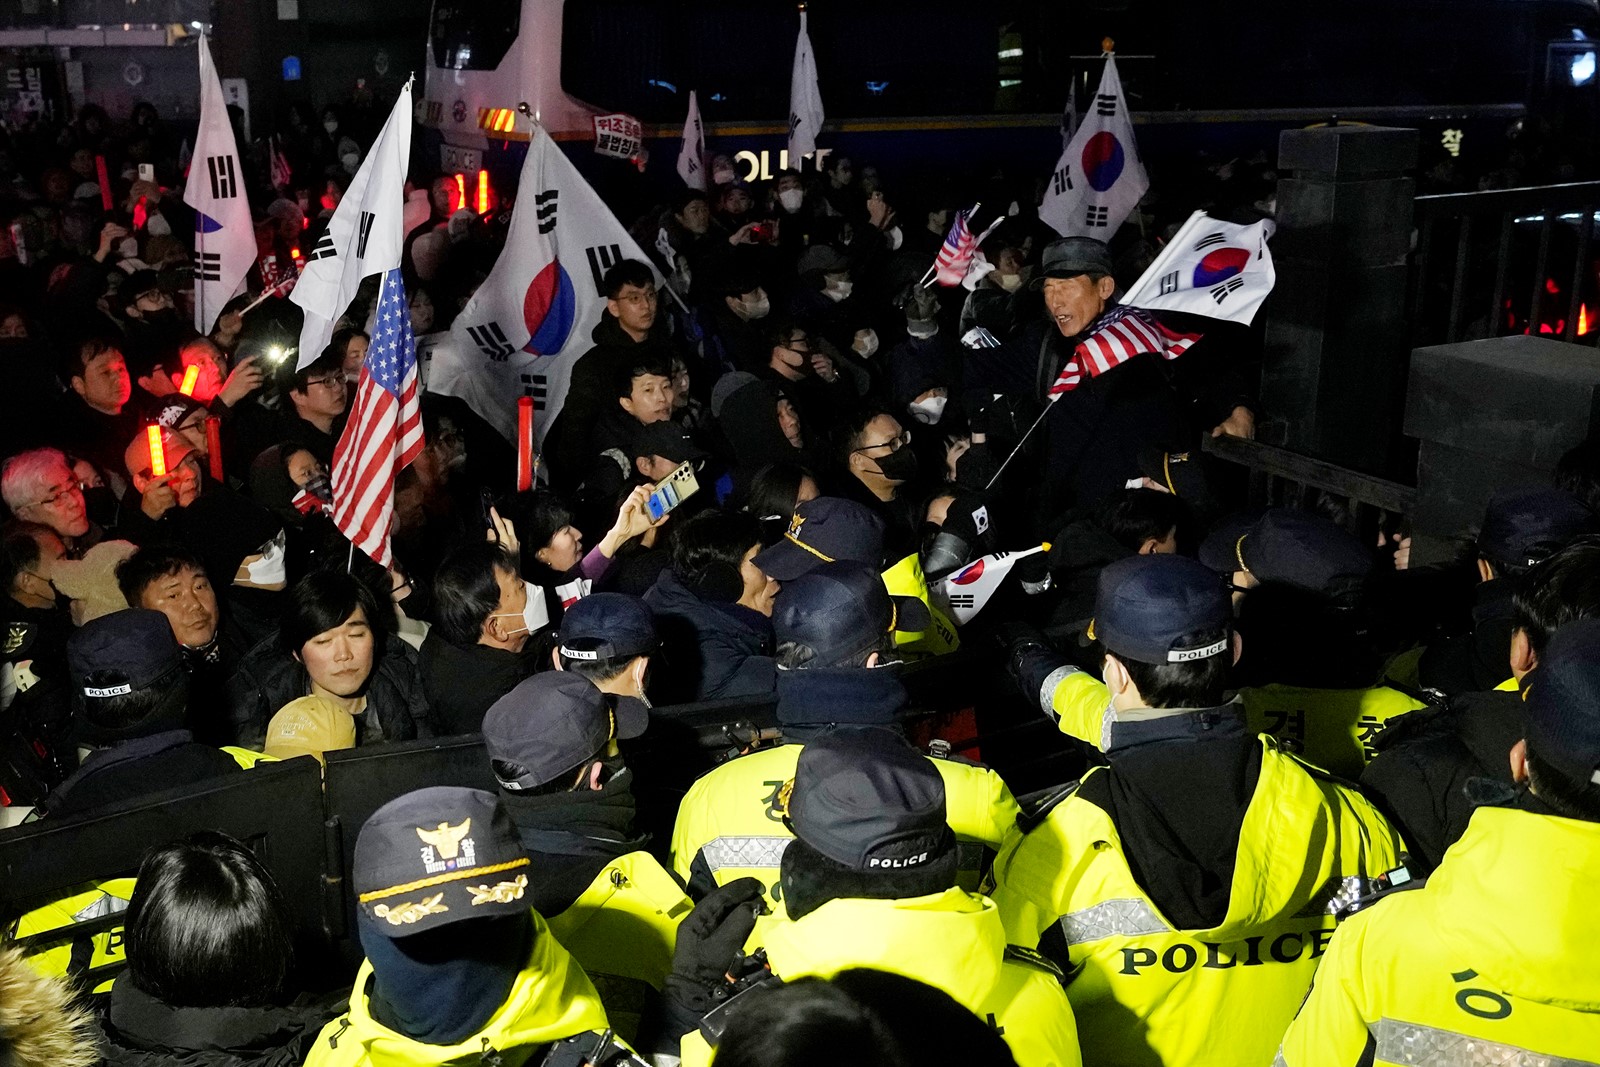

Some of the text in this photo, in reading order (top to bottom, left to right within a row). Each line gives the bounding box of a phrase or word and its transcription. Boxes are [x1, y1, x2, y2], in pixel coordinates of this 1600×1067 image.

[1178, 642, 1224, 661] POLICE
[89, 687, 127, 696] POLICE
[869, 852, 928, 868] POLICE
[1118, 929, 1335, 976] POLICE
